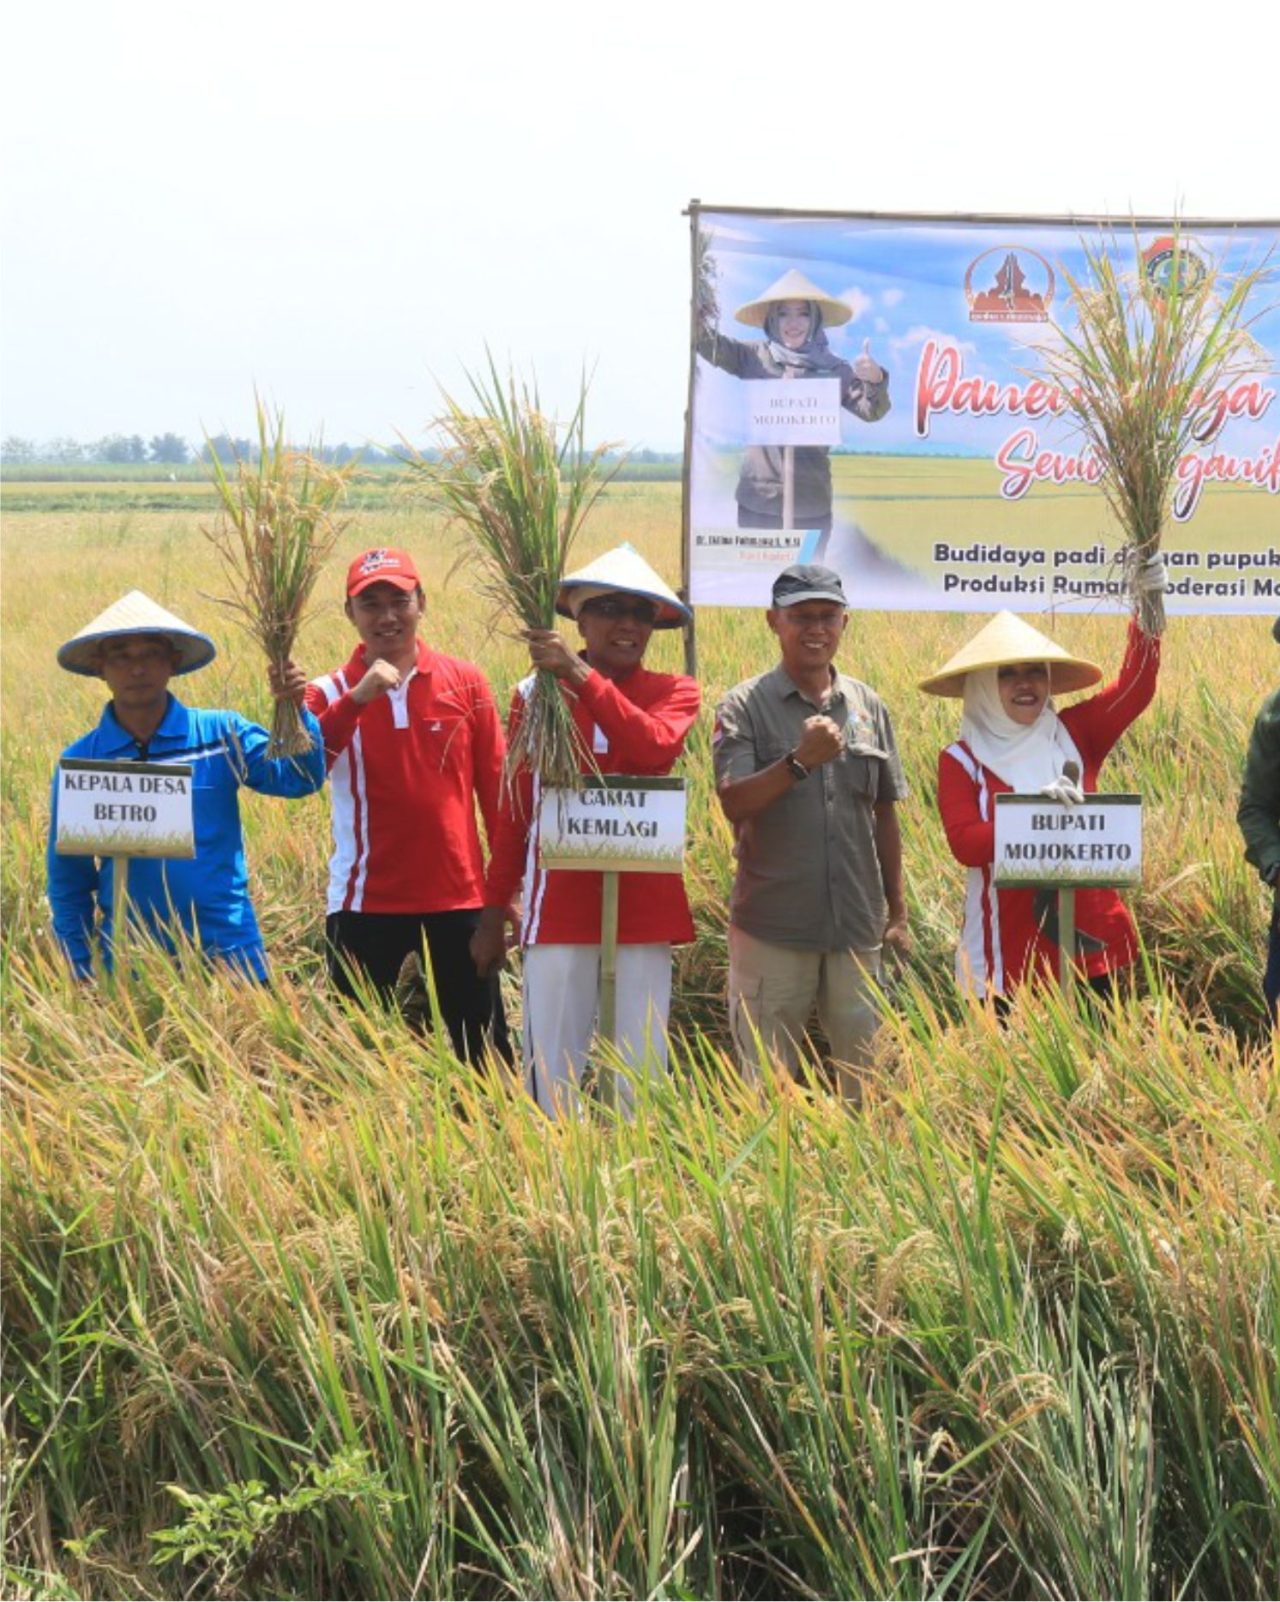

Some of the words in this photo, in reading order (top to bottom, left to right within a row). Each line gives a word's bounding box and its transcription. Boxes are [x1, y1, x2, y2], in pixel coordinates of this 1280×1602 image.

[934, 543, 1046, 567] Budidaya
[1053, 546, 1106, 567] padi
[944, 573, 1045, 593] Produksi
[1165, 577, 1245, 597] oderasi
[65, 773, 134, 793] KEPALA
[139, 777, 187, 795] DESA
[580, 789, 648, 808] CAMAT
[94, 803, 157, 822] BETRO
[1032, 813, 1105, 831] BUPATI
[567, 817, 658, 838] KEMLAGI
[1005, 843, 1132, 861] MOJOKERTO
